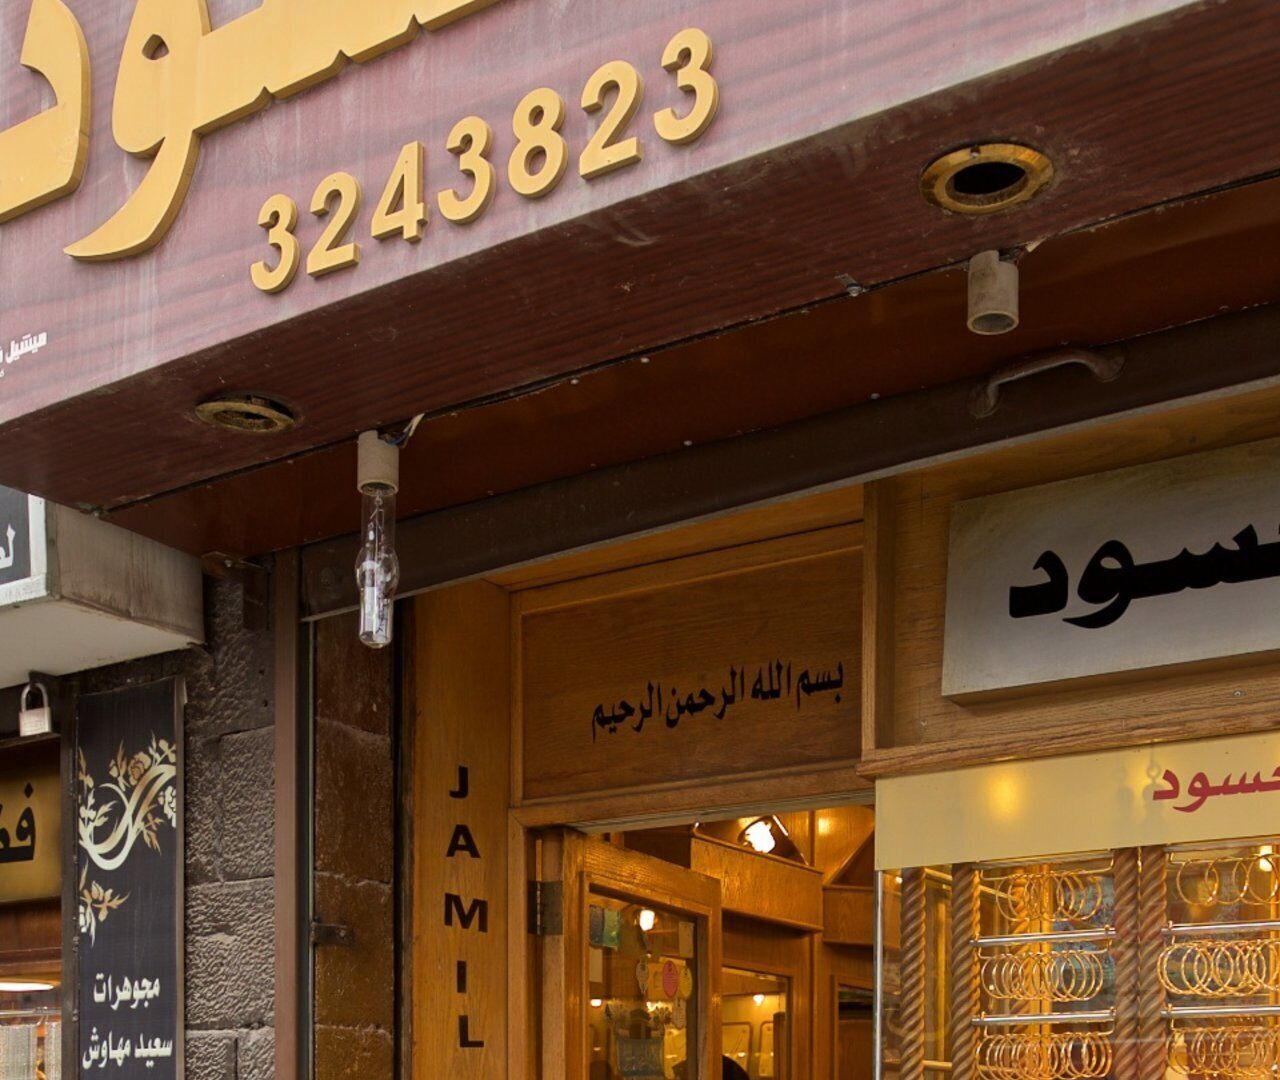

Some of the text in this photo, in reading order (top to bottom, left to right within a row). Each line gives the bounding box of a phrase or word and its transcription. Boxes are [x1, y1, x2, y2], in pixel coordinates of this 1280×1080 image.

[250, 27, 720, 294] 3243823
[591, 658, 845, 744] بسم الله الرحمن الرحيم
[444, 765, 488, 1048] JAMIL
[93, 973, 161, 1010] مجوهرات
[82, 1026, 173, 1070] سعيد مهاوش
